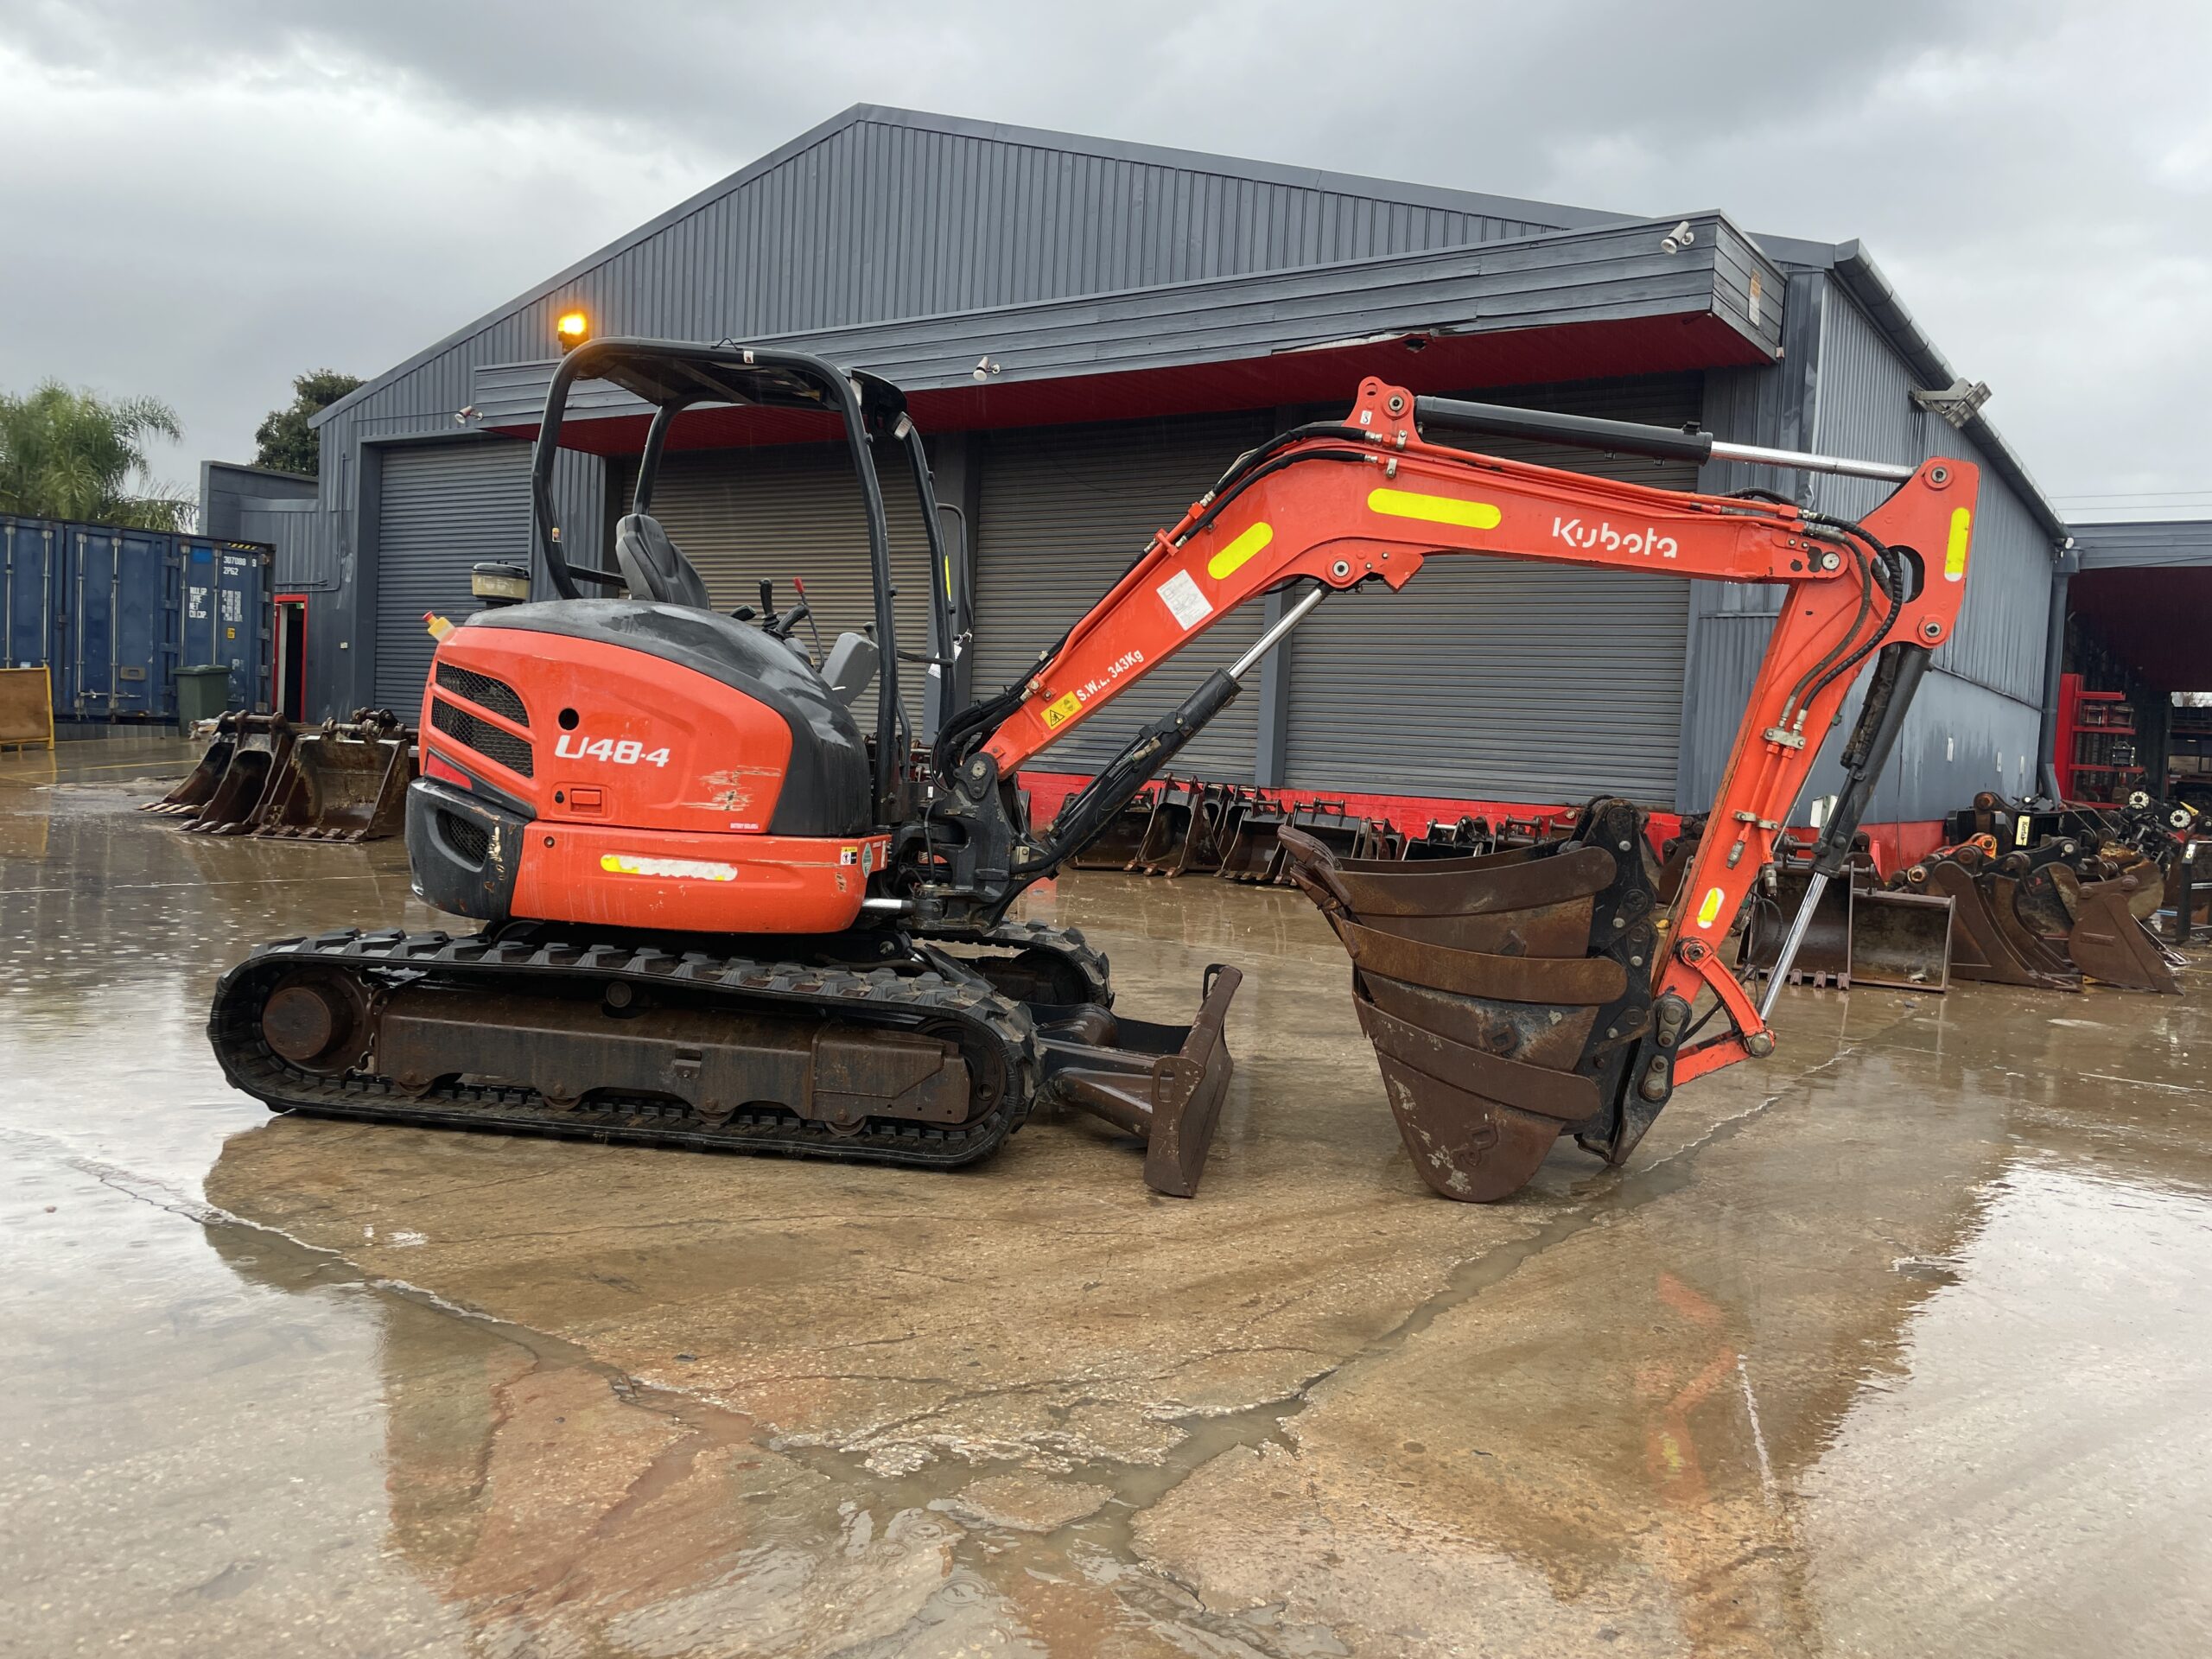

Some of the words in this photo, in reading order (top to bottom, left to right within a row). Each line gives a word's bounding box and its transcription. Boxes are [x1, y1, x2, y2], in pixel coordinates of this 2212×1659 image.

[1552, 517, 1678, 559] Kubota
[1108, 650, 1145, 678] 343Kg
[555, 734, 671, 768] U48-4
